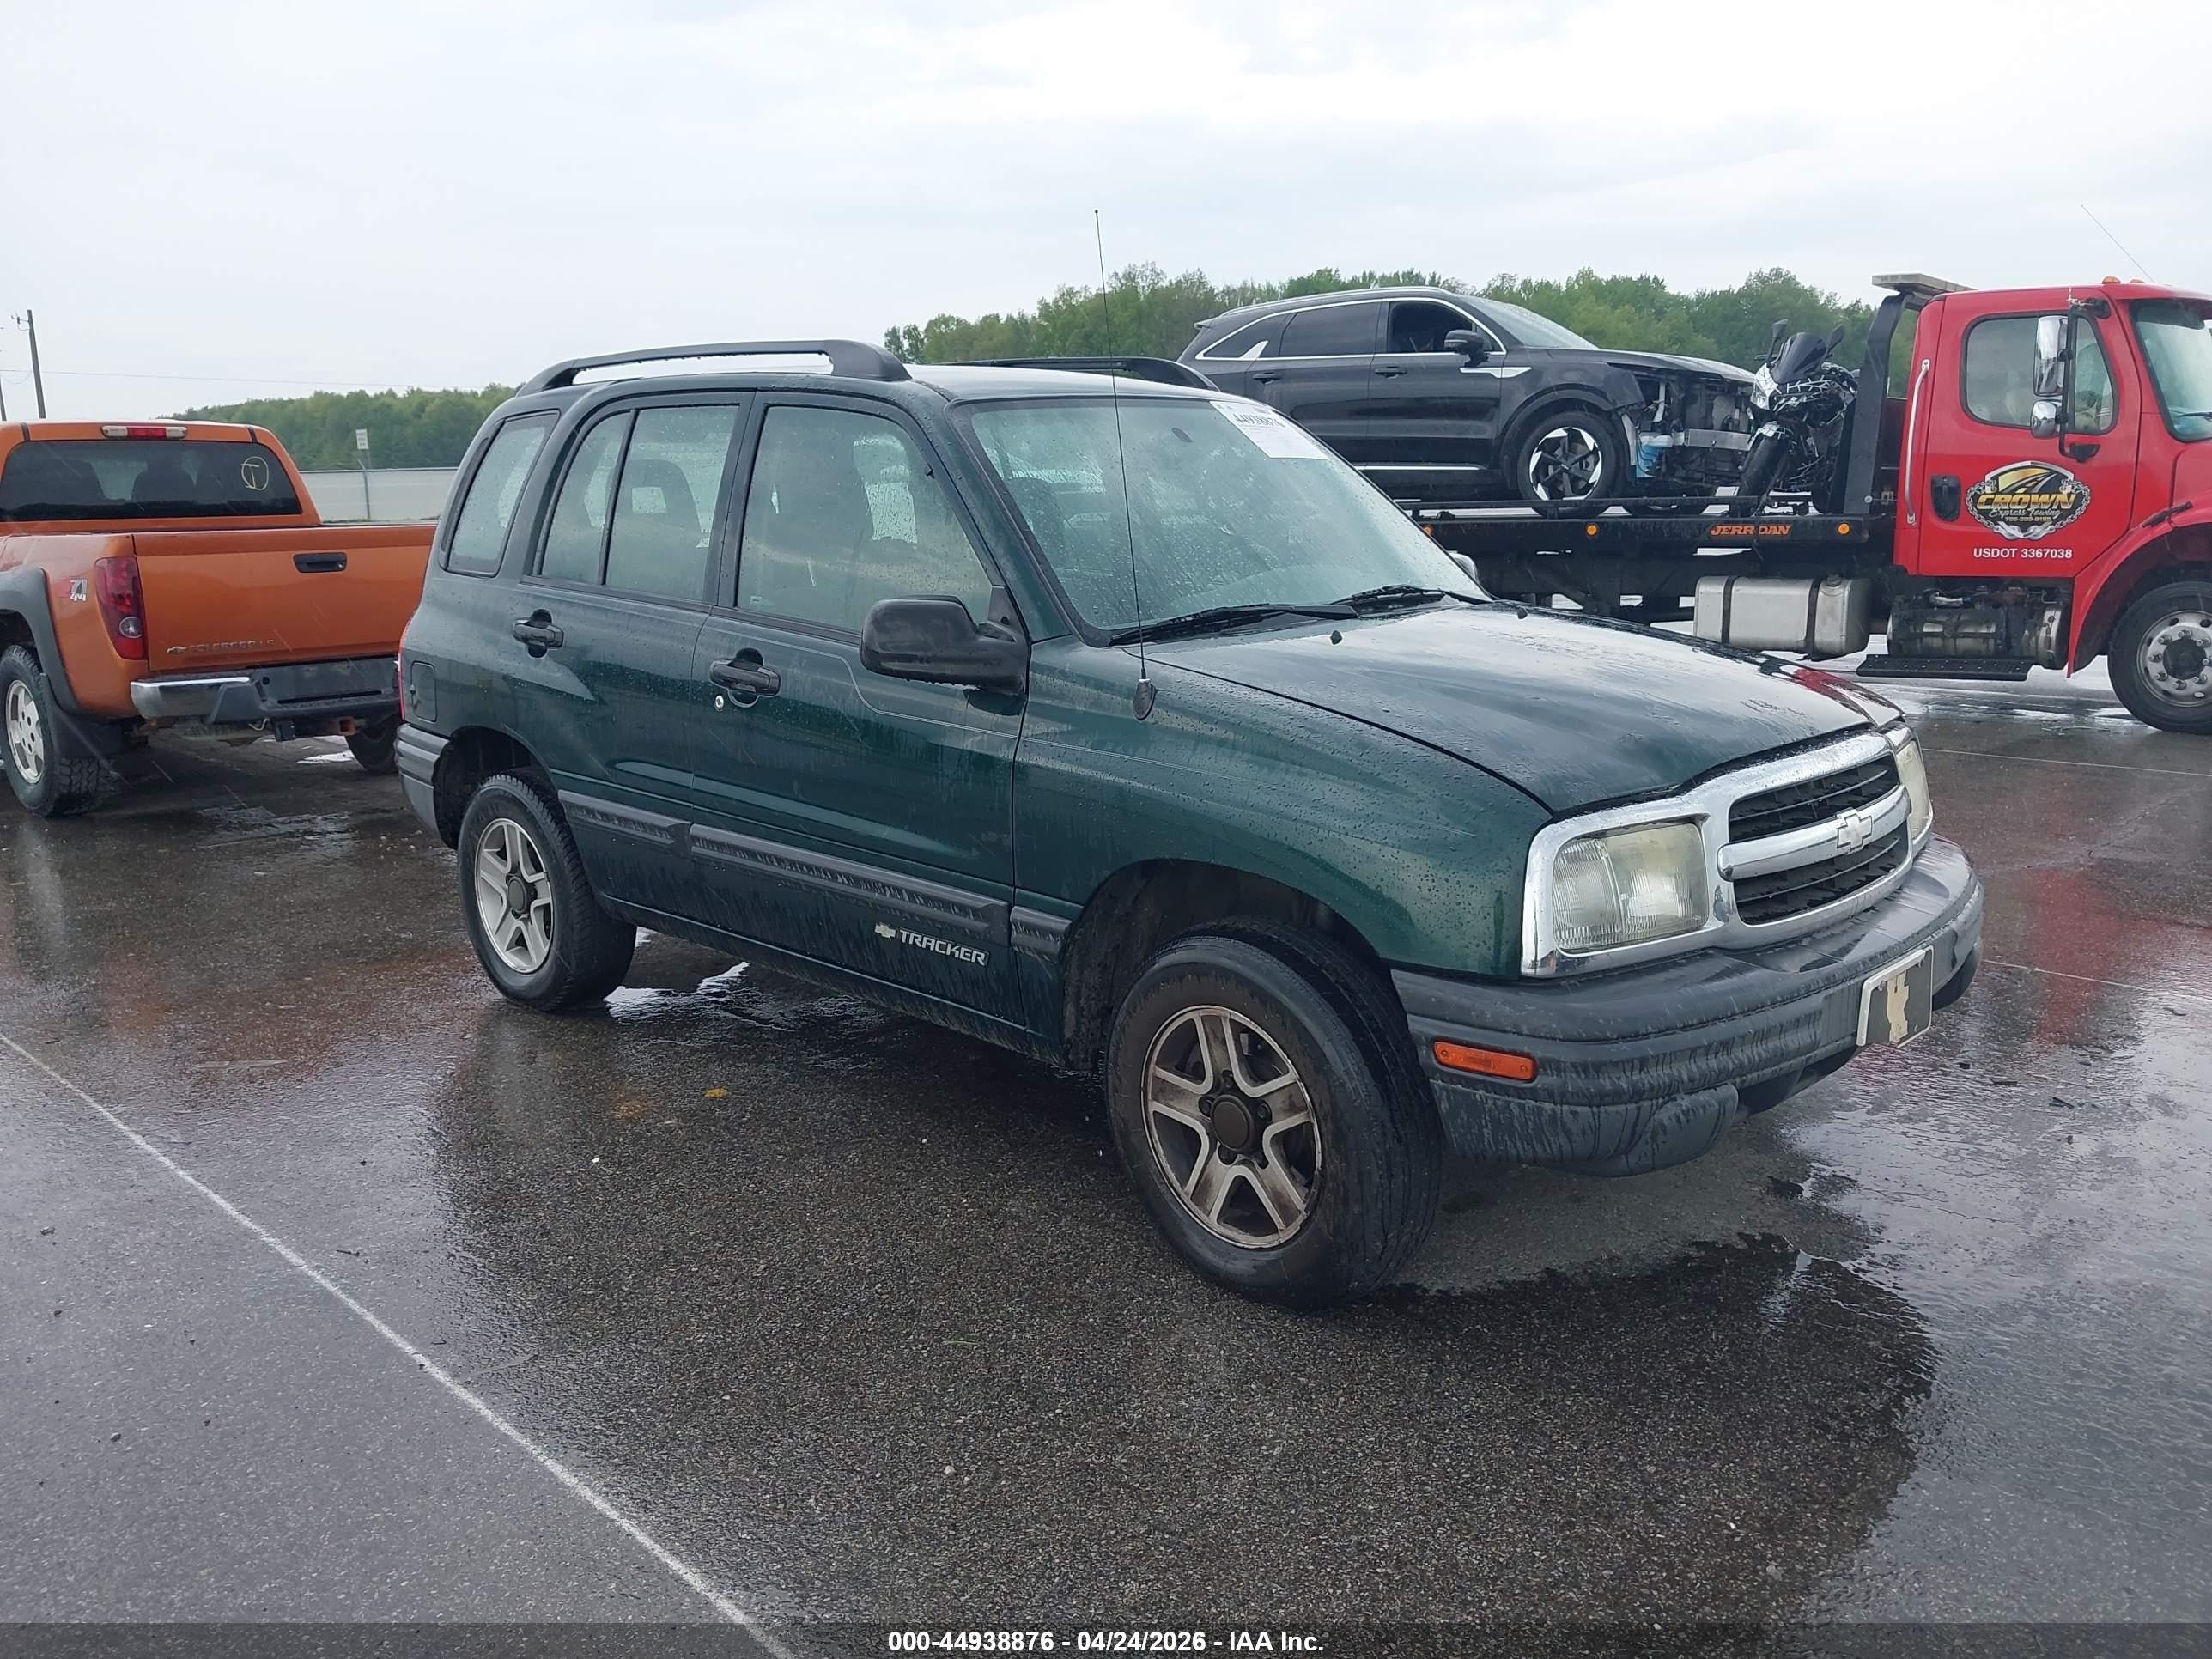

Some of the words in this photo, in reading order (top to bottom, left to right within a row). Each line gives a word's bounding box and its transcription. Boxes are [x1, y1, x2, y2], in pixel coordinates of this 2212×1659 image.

[1976, 494, 2075, 509] CROWN
[1989, 507, 2026, 519] Express
[2027, 508, 2061, 520] Towing
[1973, 548, 2018, 558] USDOT
[2021, 548, 2072, 559] 3367038
[900, 929, 986, 967] TRACKER
